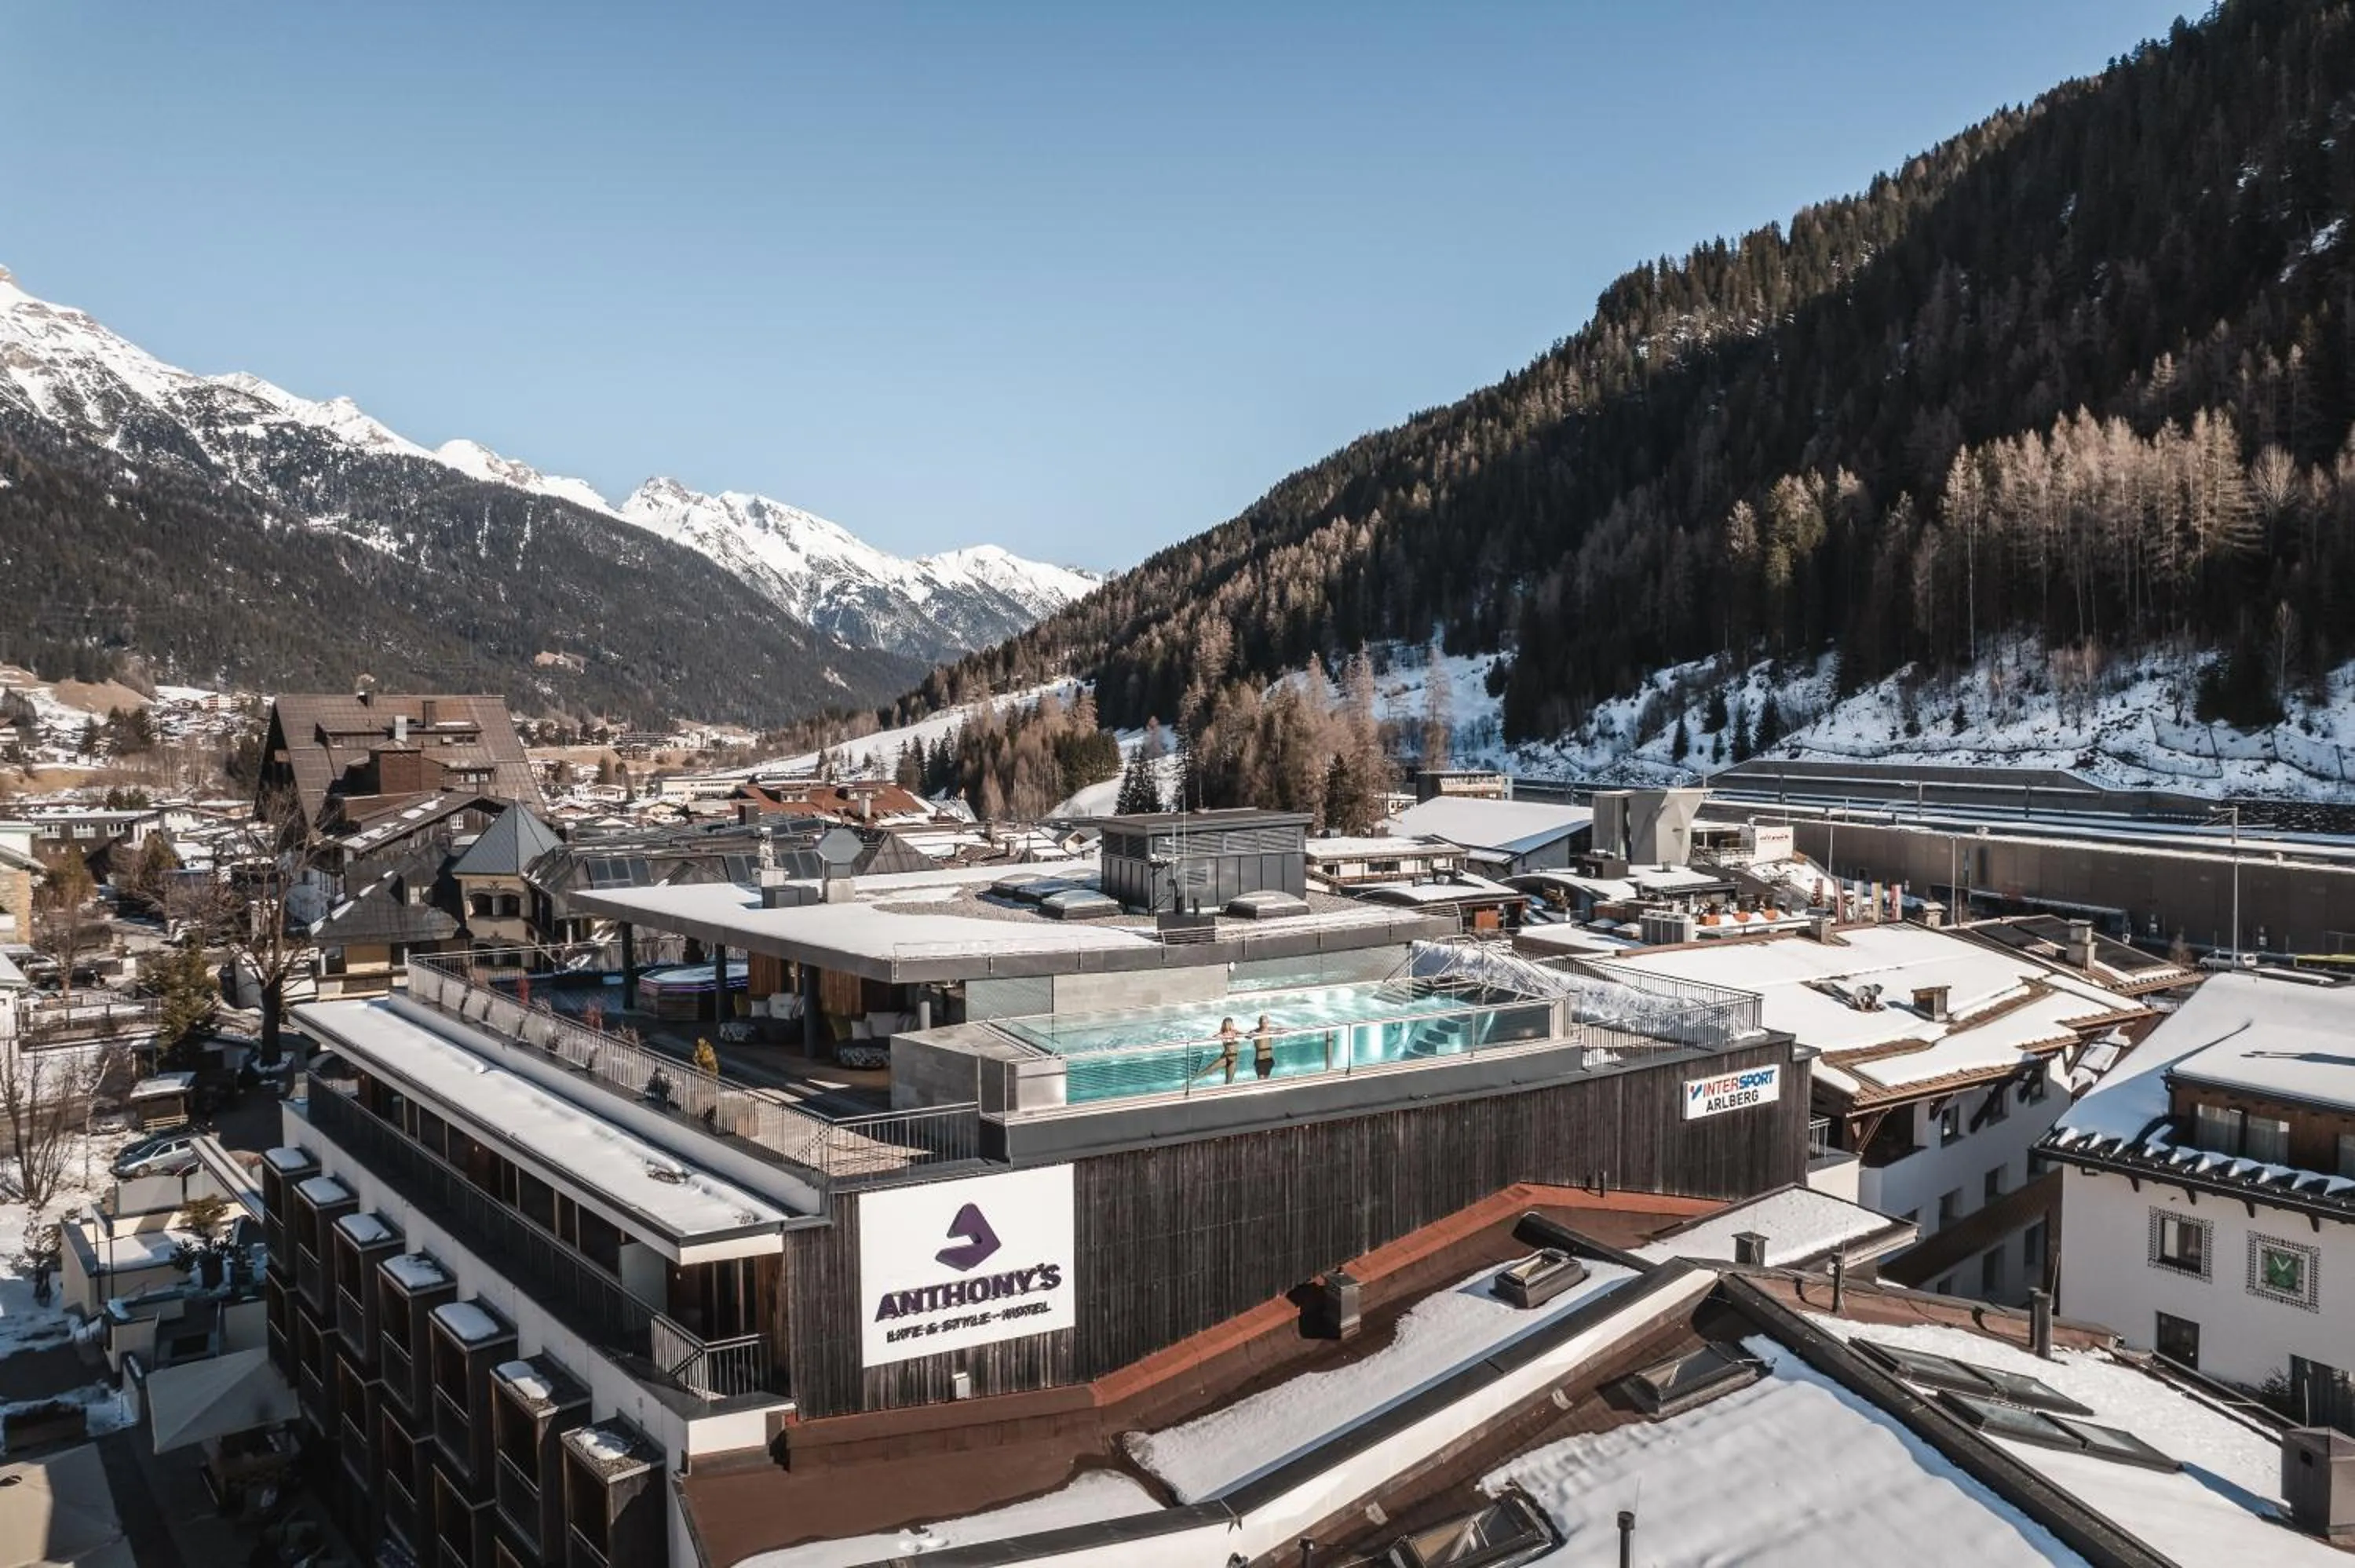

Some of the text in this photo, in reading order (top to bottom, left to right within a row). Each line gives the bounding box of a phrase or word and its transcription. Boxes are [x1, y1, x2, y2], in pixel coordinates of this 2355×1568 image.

[1703, 1070, 1774, 1097] INTERSPORT
[1707, 1089, 1759, 1112] ARLBERG
[874, 1263, 1062, 1322] ANTHONY'S
[887, 1325, 923, 1343] LIFE
[927, 1322, 937, 1335] &
